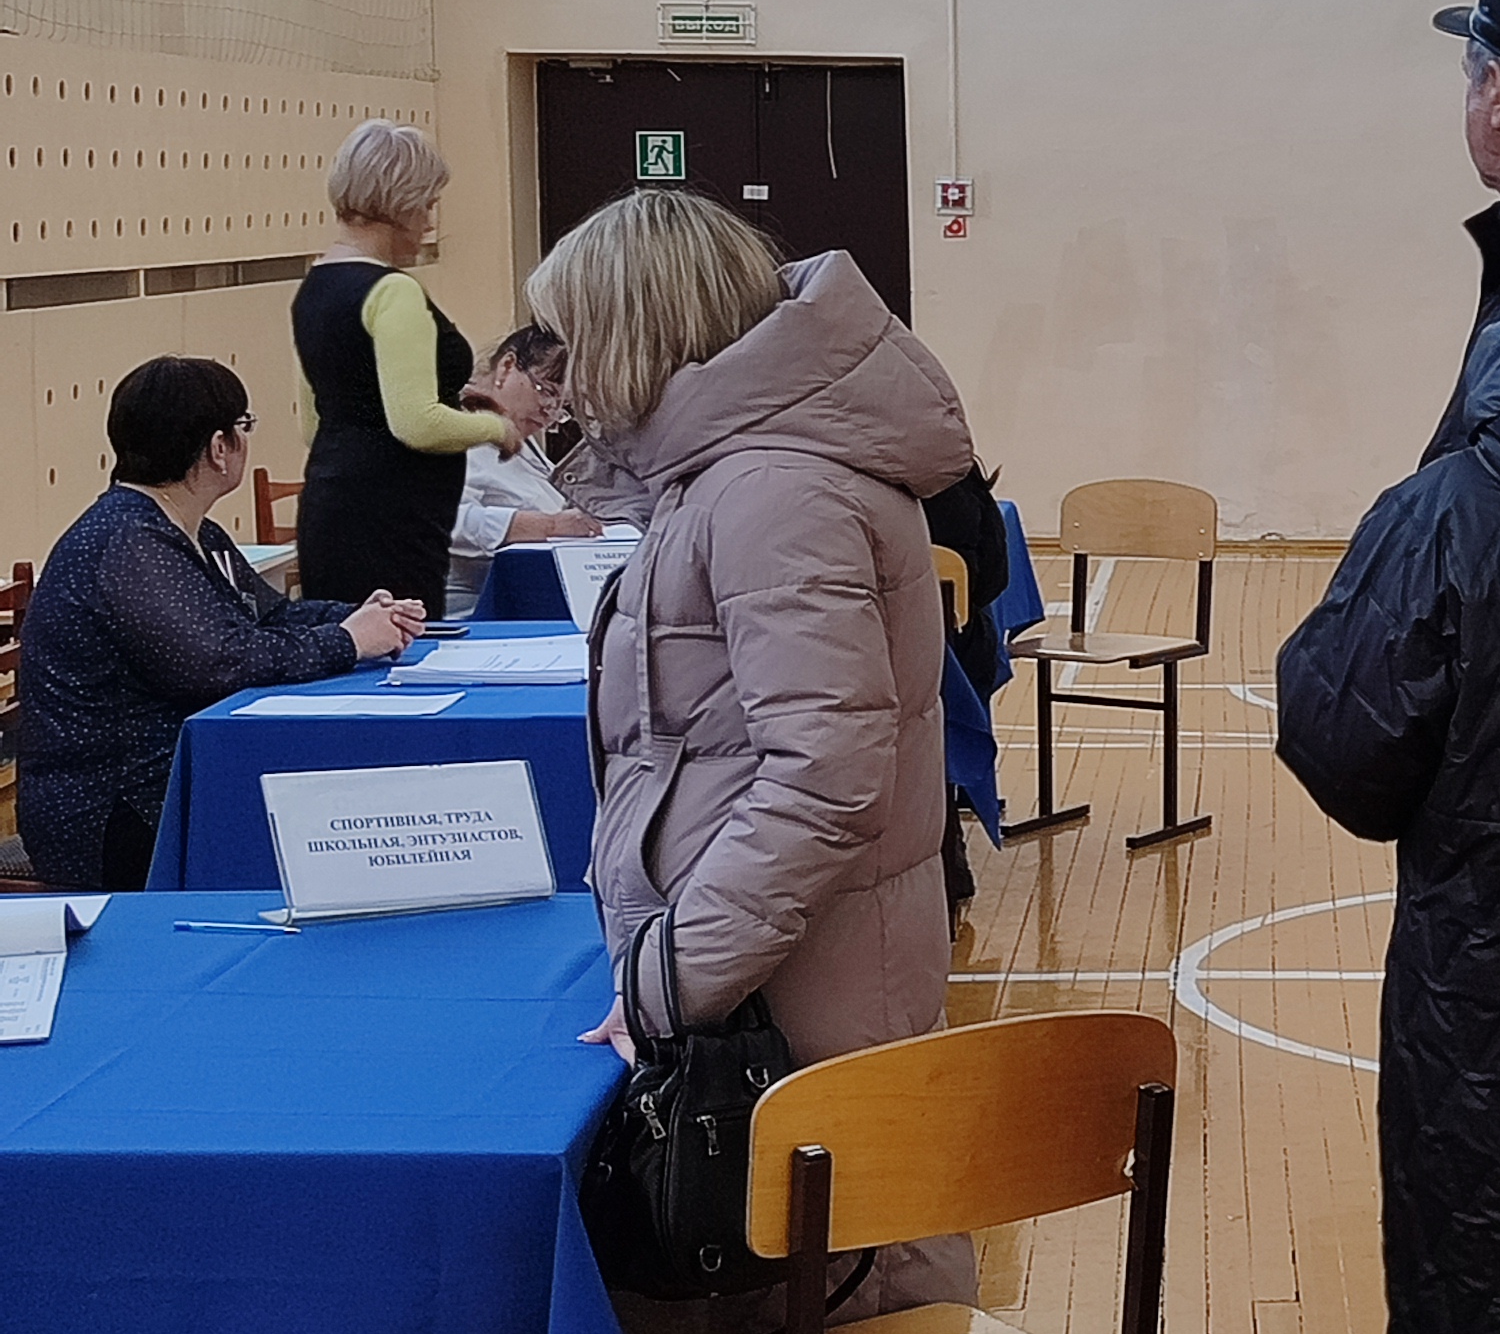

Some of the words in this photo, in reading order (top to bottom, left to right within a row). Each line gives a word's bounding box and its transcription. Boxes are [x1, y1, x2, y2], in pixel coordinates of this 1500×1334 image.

[330, 814, 443, 831] СПОРТИВНАЯ,
[444, 810, 493, 825] ТРУДА
[307, 836, 405, 853] ШКОЛЬНАЯ,
[407, 828, 524, 847] ЭНТУЗИАСТОВ,
[368, 849, 472, 867] ЮБИЛЕЙНАЯ
